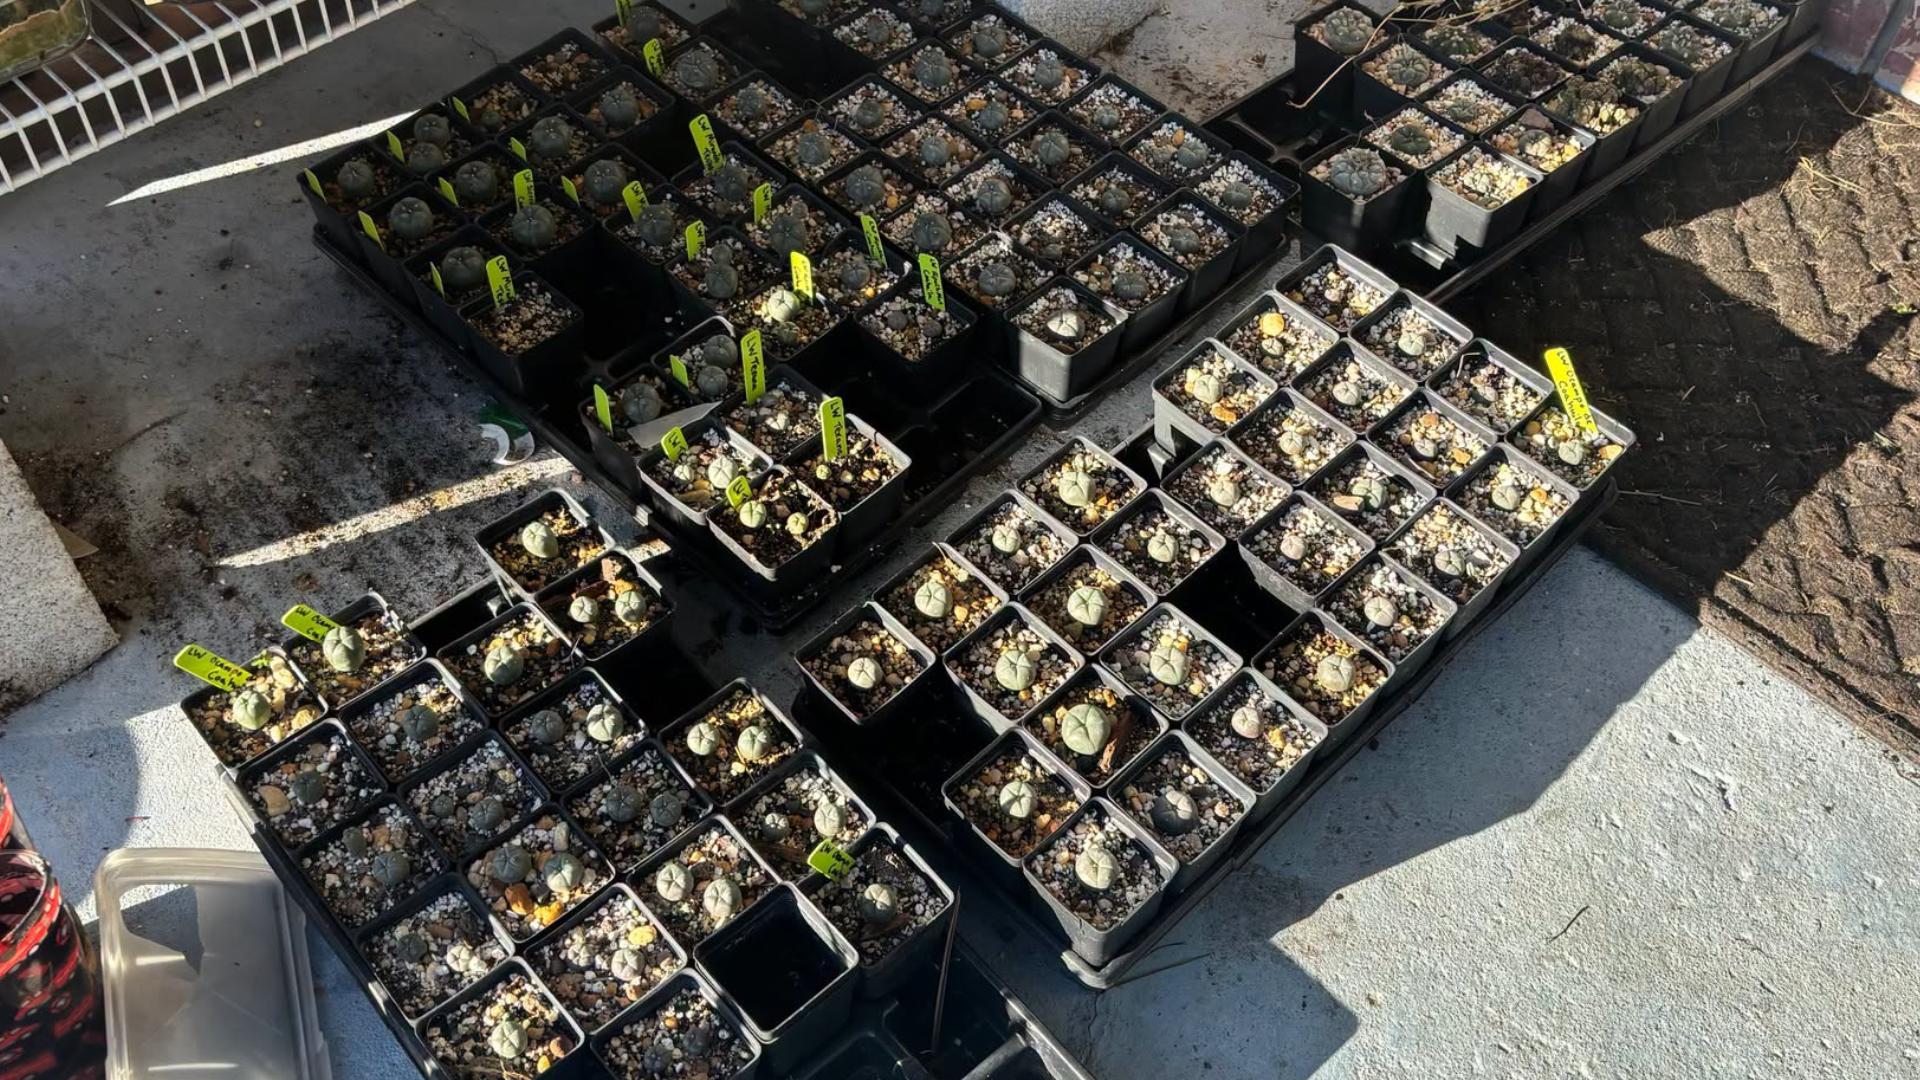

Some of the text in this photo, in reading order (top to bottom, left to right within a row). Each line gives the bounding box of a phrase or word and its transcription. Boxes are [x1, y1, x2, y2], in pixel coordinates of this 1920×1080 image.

[496, 257, 508, 273] LW
[746, 335, 757, 356] LW
[1556, 351, 1569, 366] LW
[1566, 370, 1585, 409] Ocampo
[830, 401, 842, 418] LW
[668, 432, 679, 447] LW
[294, 606, 310, 617] LW
[187, 647, 242, 677] LW Ocampo
